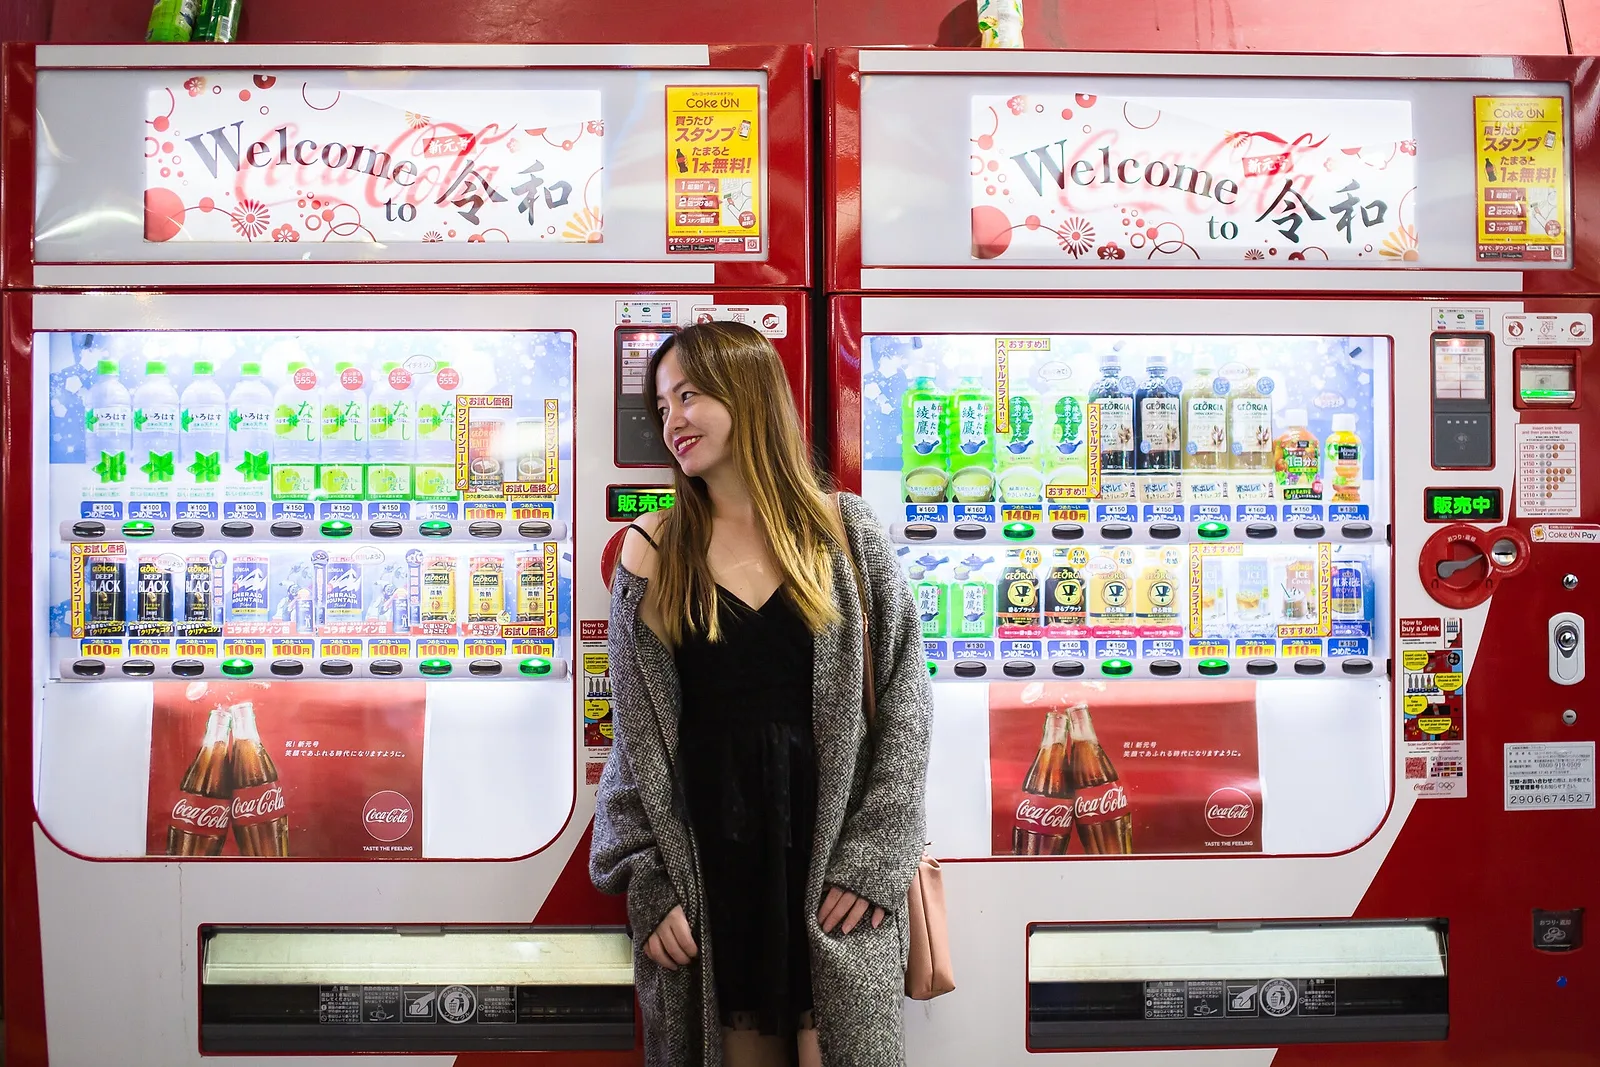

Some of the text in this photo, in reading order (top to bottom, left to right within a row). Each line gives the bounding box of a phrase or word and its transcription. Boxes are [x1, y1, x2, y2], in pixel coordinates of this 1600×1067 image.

[686, 97, 739, 108] Coke ON
[1494, 108, 1544, 118] Coke ON
[676, 116, 713, 126] 買うたび
[675, 127, 736, 142] スタンプ
[1484, 137, 1542, 151] スタンプ
[186, 120, 417, 188] Welcome
[692, 147, 729, 156] たまると
[1500, 156, 1535, 165] たまると
[1010, 140, 1238, 205] Welcome
[435, 160, 572, 226] 令和
[383, 198, 416, 222] to
[1256, 179, 1387, 244] 令和
[1207, 215, 1238, 240] to
[1009, 341, 1047, 349] おすすめ!!
[469, 398, 510, 406] お試し価格
[458, 408, 466, 478] ワンコインコーナー
[548, 413, 556, 482] ワンコインコーナー
[506, 484, 546, 493] お試し価格
[618, 494, 675, 512] 販売中
[1434, 496, 1490, 514] 販売中
[1582, 532, 1596, 540] Pay
[83, 545, 124, 554] お試し価格
[73, 557, 82, 626] ワンコインコーナー
[91, 581, 120, 593] BLACK
[138, 581, 169, 593] BLACK
[546, 556, 555, 626] ワンコインコーナー
[504, 627, 546, 636] お試し価格
[85, 645, 120, 655] 100円
[133, 645, 167, 655] 100円
[179, 645, 214, 655] 100円
[228, 645, 262, 655] 100円
[275, 645, 309, 655] 100円
[324, 645, 358, 655] 100円
[232, 787, 285, 820] Coca-Cola
[1074, 786, 1128, 819] Coca-Cola
[1510, 794, 1590, 804] 2906674527
[172, 798, 230, 830] Coca-Cola
[366, 808, 410, 824] Coca-Cola
[1016, 799, 1074, 828] Coca-Cola
[1208, 805, 1250, 820] Coca-Cola
